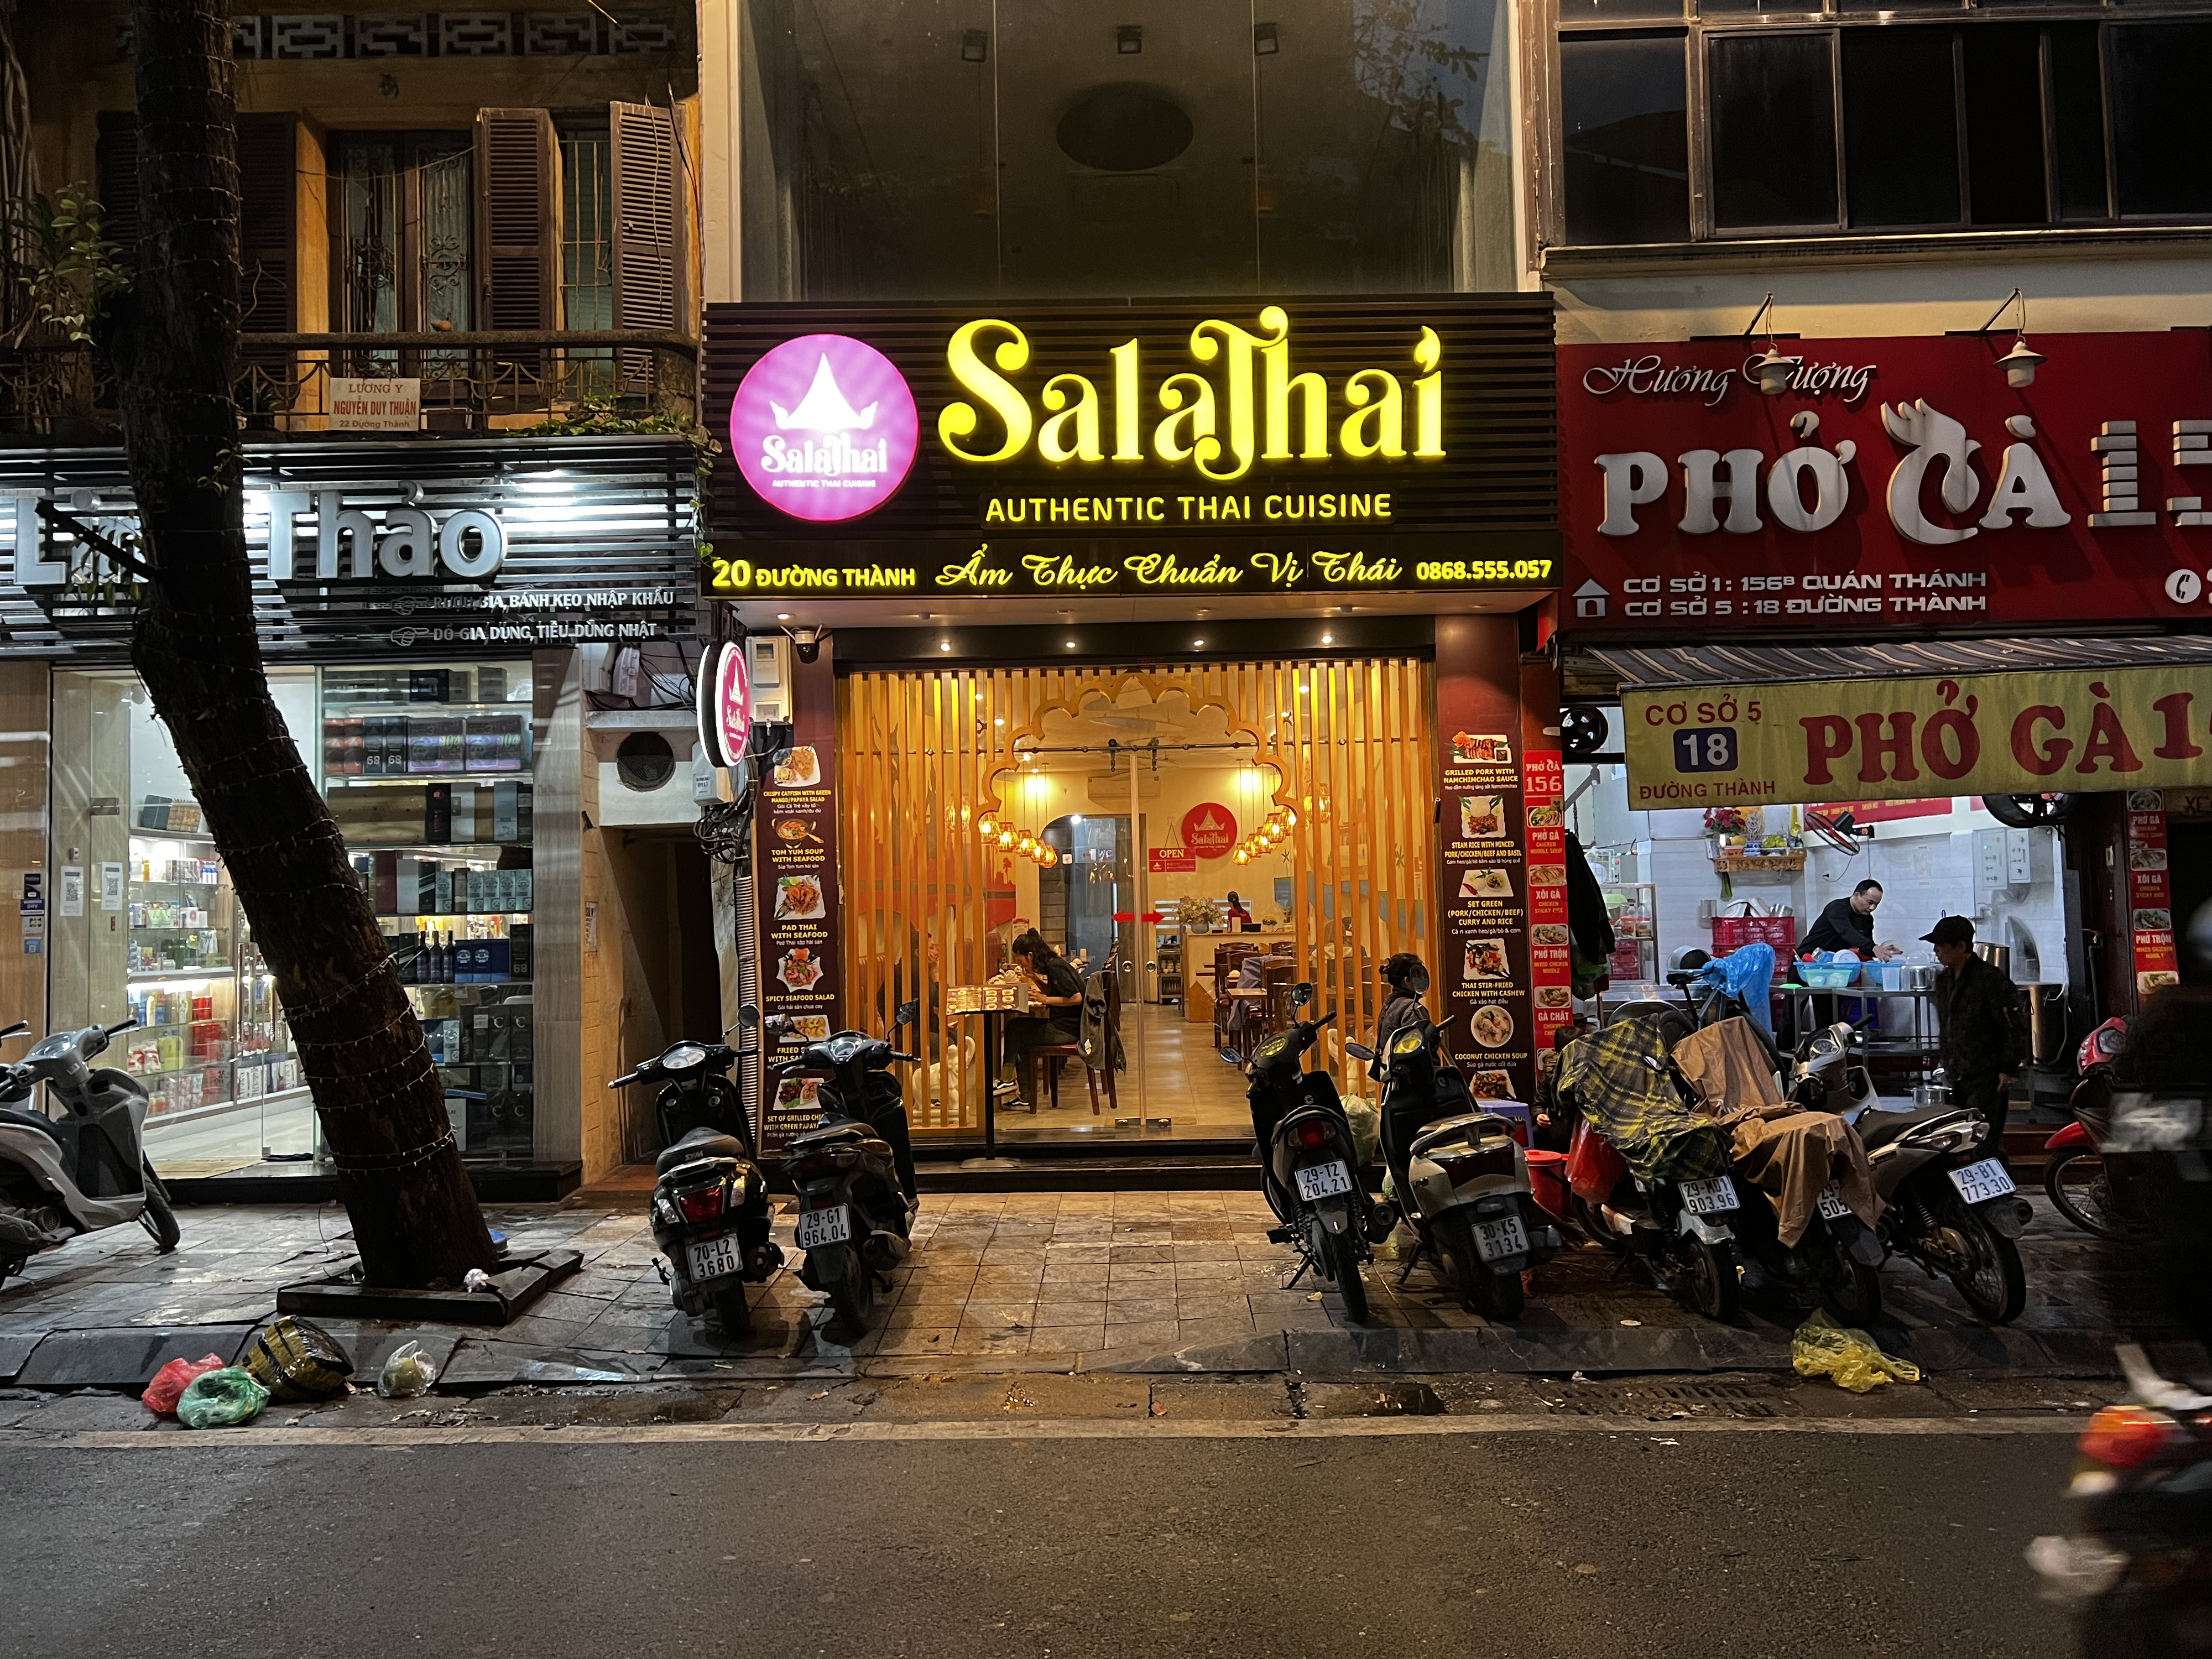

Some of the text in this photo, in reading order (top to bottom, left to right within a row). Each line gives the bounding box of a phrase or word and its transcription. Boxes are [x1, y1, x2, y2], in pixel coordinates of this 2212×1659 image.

[395, 384, 403, 393] Y
[1583, 354, 1736, 406] Hương
[333, 395, 417, 418] NGUYỄN DUY THUẬN
[352, 420, 380, 429] Đường
[1594, 410, 1857, 536] PHỞ
[985, 493, 1392, 523] AUTHENTIC THAI CUISINE
[243, 480, 508, 581] Thảo
[712, 559, 916, 587] 20 ĐƯỜNG THÀNH
[935, 543, 1404, 589] Ẩm Thực Chuẩn Vị Thái
[1416, 560, 1552, 580] 0868.555.057
[1624, 576, 1661, 593] CƠ
[1670, 571, 1707, 593] SỞ
[1802, 570, 1881, 591] QUÁN
[1888, 569, 1986, 589] THÁNH
[509, 592, 549, 608] BÁNH
[553, 594, 580, 609] KẸO
[587, 591, 627, 609] NHẬP
[633, 586, 674, 606] KHẨU
[1625, 599, 1661, 617] CƠ
[1670, 595, 1707, 616] SỞ
[1785, 596, 1881, 614] ĐƯỜNG
[1888, 592, 1986, 613] THÀNH
[460, 625, 486, 640] GIA
[618, 619, 657, 639] NHẬT
[1645, 693, 1762, 726] CƠ SỞ 5
[1799, 680, 2212, 785] PHỞ GÀ 1
[367, 755, 380, 765] 68
[388, 755, 401, 765] 68
[1682, 733, 1729, 766] 18
[1526, 761, 1545, 771] PHỞ
[1526, 776, 1562, 791] 156
[1640, 778, 1775, 800] ĐƯỜNG THÀNH
[1532, 828, 1559, 841] PHỞ GÀ
[1160, 849, 1184, 858] OPEN
[2137, 873, 2162, 884] XÔI GÀ
[1536, 889, 1561, 899] XÔI GÀ
[1448, 909, 1523, 918] (PORK/CHICKEN/BEEF)
[2136, 932, 2172, 945] PHỞ TRỘN
[1534, 947, 1567, 960] PHỞ TRỘN
[513, 964, 527, 973] 68
[1538, 1010, 1569, 1022] GÀ CHẶT
[685, 1150, 703, 1161] SYM
[1304, 1164, 1340, 1183] 29-T2
[1958, 1162, 1992, 1184] 29-B1
[1303, 1176, 1348, 1198] 204.21
[1961, 1177, 2010, 1201] 773.30
[1689, 1193, 1735, 1213] 903.96
[806, 1207, 841, 1229] 29-G1
[804, 1224, 847, 1246] 964.04
[695, 1239, 732, 1262] 70-L2
[698, 1255, 734, 1279] 3680
